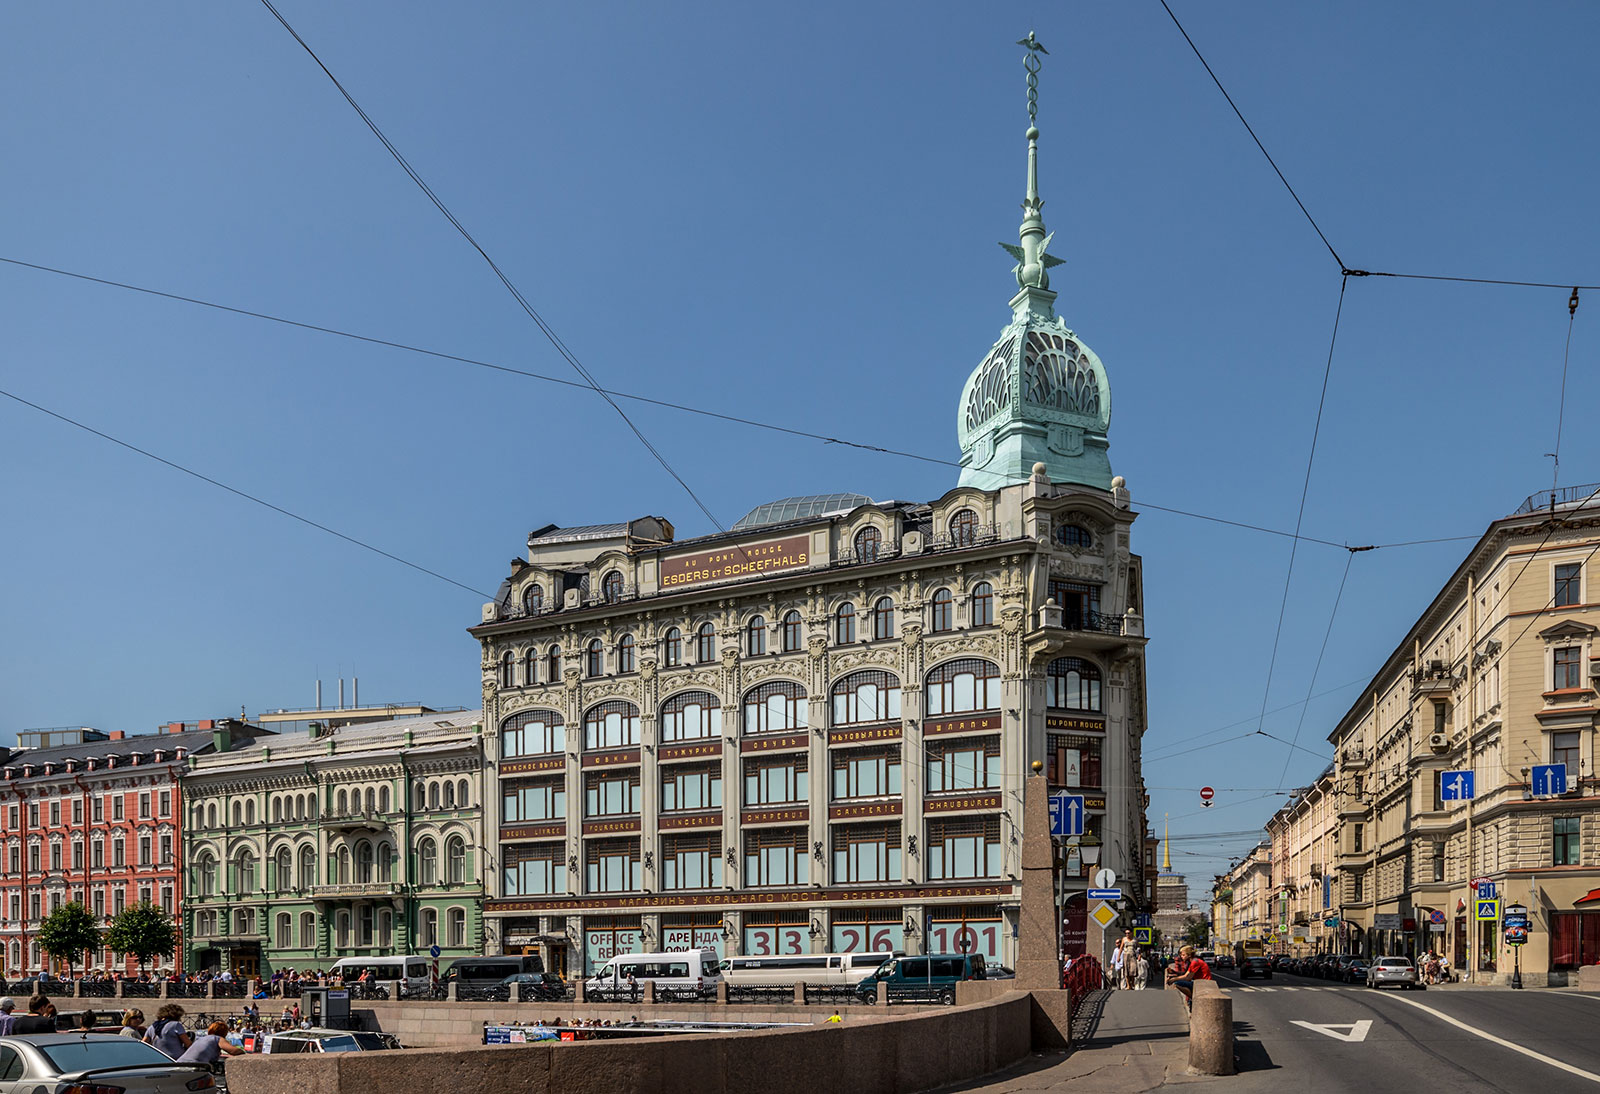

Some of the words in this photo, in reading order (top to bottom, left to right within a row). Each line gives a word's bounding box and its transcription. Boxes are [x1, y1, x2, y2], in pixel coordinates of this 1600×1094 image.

[685, 559, 697, 567] AU
[709, 553, 734, 563] PONT
[748, 545, 782, 557] ROUGE
[663, 569, 709, 586] ESDERS
[712, 570, 721, 578] ET
[724, 553, 807, 576] SCHEEFHALS
[936, 720, 988, 732] ШЛЯПЫ
[1059, 720, 1077, 728] PONT
[1080, 721, 1103, 729] ROUGE
[877, 729, 899, 737] ВЕЩИ
[753, 738, 796, 749] ОБУВЬ
[667, 746, 715, 757] ТУЖУРКИ
[929, 798, 997, 809] CHAUSSURES
[747, 811, 803, 821] CHAPEAUX
[836, 805, 895, 816] GANTERIE
[666, 817, 715, 826] LINGERIE
[589, 823, 634, 832] FOURRURES
[619, 896, 685, 906] МАГАЗИНЪ
[692, 896, 699, 904] У
[705, 894, 774, 904] КРАСНАГО
[781, 892, 828, 902] МОСТА
[590, 933, 634, 945] OFFICE
[668, 932, 719, 945] АРЕНДА
[933, 926, 996, 957] 101
[598, 947, 632, 959] RENT
